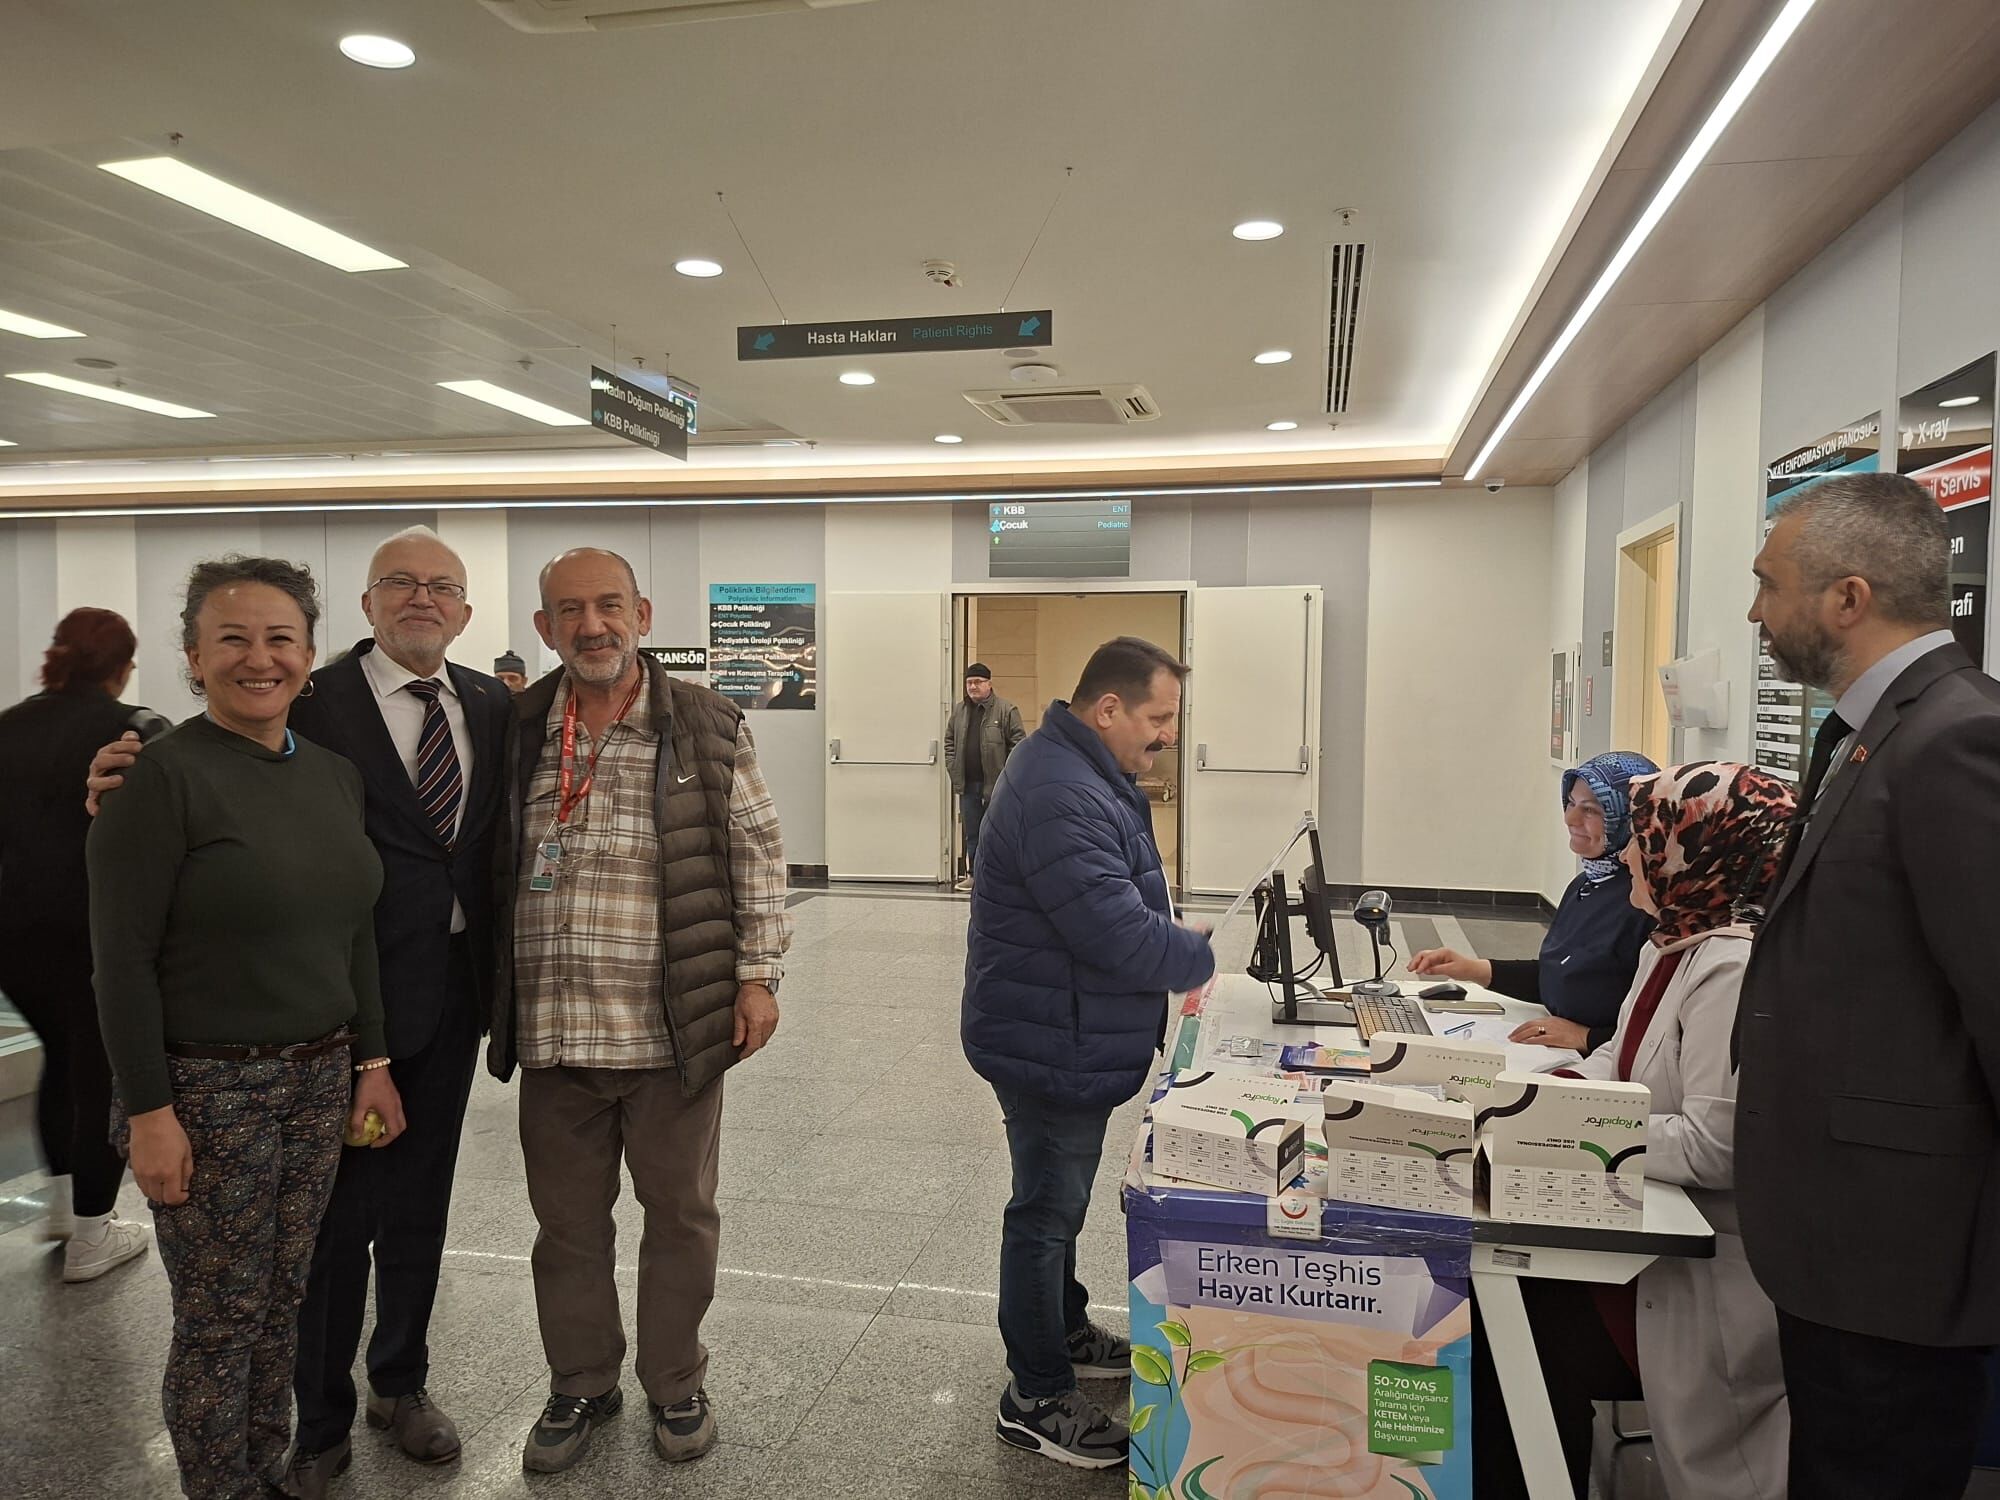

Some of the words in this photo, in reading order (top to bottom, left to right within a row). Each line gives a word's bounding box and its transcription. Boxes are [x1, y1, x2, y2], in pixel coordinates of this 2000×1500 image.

[807, 331, 846, 344] Hasta
[850, 329, 897, 344] Hakları
[912, 325, 953, 339] Patient
[956, 324, 993, 338] Rights
[603, 380, 626, 402] Kadın
[627, 390, 653, 413] Doğum
[654, 402, 685, 430] Polikliniği
[603, 411, 622, 430] KBB
[624, 420, 660, 447] Polikliniği
[1917, 417, 1950, 445] X-ray
[1785, 439, 1837, 474] ENFORMASYON
[1838, 422, 1872, 450] PANOSU
[1940, 467, 1981, 498] Servis
[1003, 506, 1025, 515] KBB
[1000, 520, 1028, 530] Çocuk
[1097, 521, 1128, 529] Pediatric
[719, 586, 753, 594] Poliklinik
[651, 650, 705, 664] SANSÖR
[1241, 1093, 1280, 1104] RapidFor
[1584, 1116, 1633, 1129] RapidFor
[1412, 1128, 1456, 1139] RapidFor
[1517, 1140, 1562, 1148] PROFESSIONAL
[1198, 1247, 1278, 1277] Erken
[1287, 1254, 1381, 1287] Teşhis
[1198, 1277, 1273, 1306] Hayat
[1280, 1283, 1382, 1314] Kurtarır.
[1374, 1375, 1410, 1389] 50-70
[1412, 1380, 1437, 1394] YAŞ
[1374, 1388, 1449, 1403] Aralığındaysanız
[1374, 1398, 1407, 1410] Tarama
[1409, 1403, 1426, 1413] için
[1374, 1409, 1407, 1420] KETEM
[1409, 1414, 1430, 1423] veya
[1374, 1420, 1392, 1429] Aile
[1394, 1422, 1445, 1434] Hekiminize
[1374, 1430, 1418, 1443] Başvurun.
